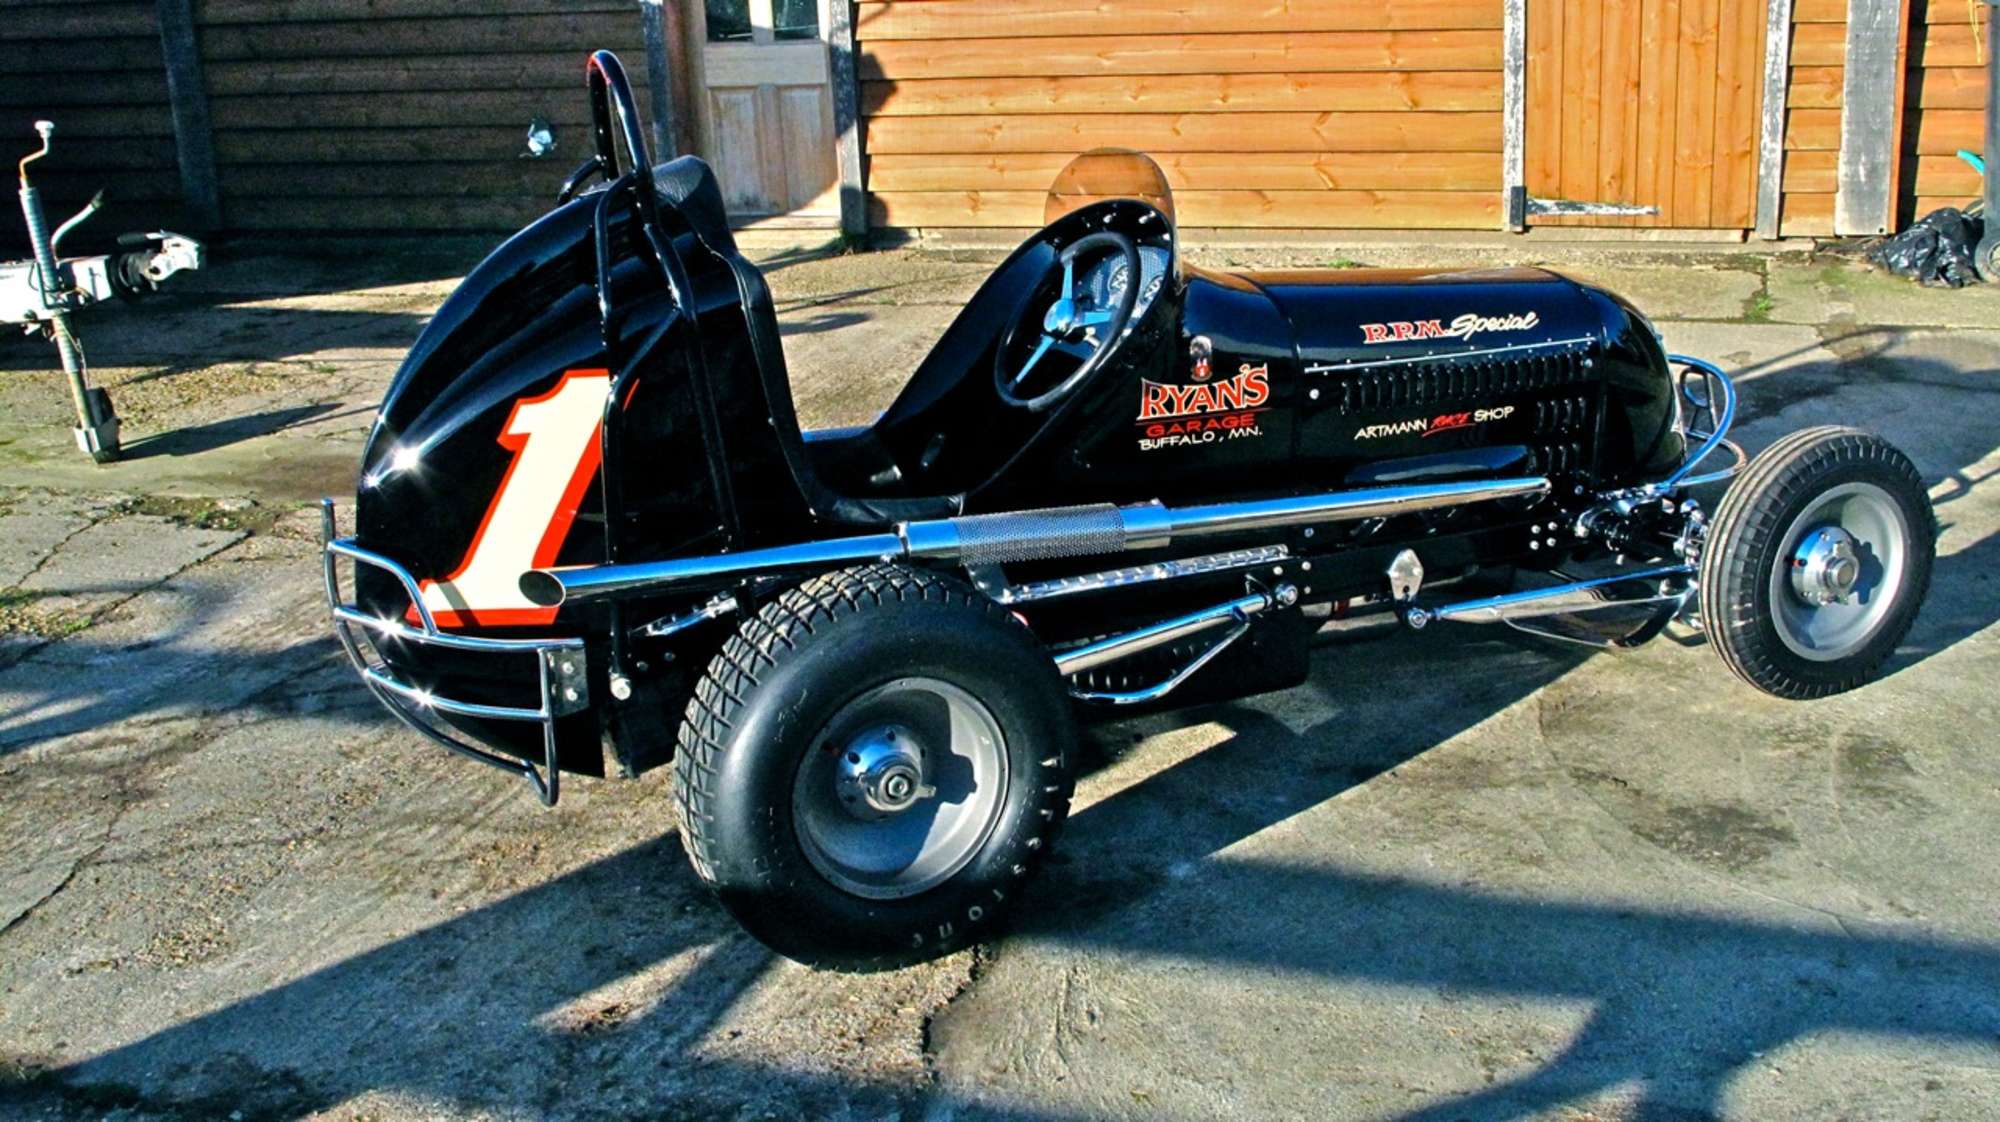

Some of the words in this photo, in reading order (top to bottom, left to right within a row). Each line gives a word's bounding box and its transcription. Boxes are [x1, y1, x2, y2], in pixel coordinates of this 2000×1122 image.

[1450, 311, 1540, 341] Special
[1136, 363, 1270, 421] RYAN'S
[1146, 413, 1256, 438] GARAGE
[1228, 426, 1264, 440] MN.
[1354, 418, 1428, 440] ARTMANN
[1473, 406, 1515, 423] SHOP
[405, 368, 640, 627] 1
